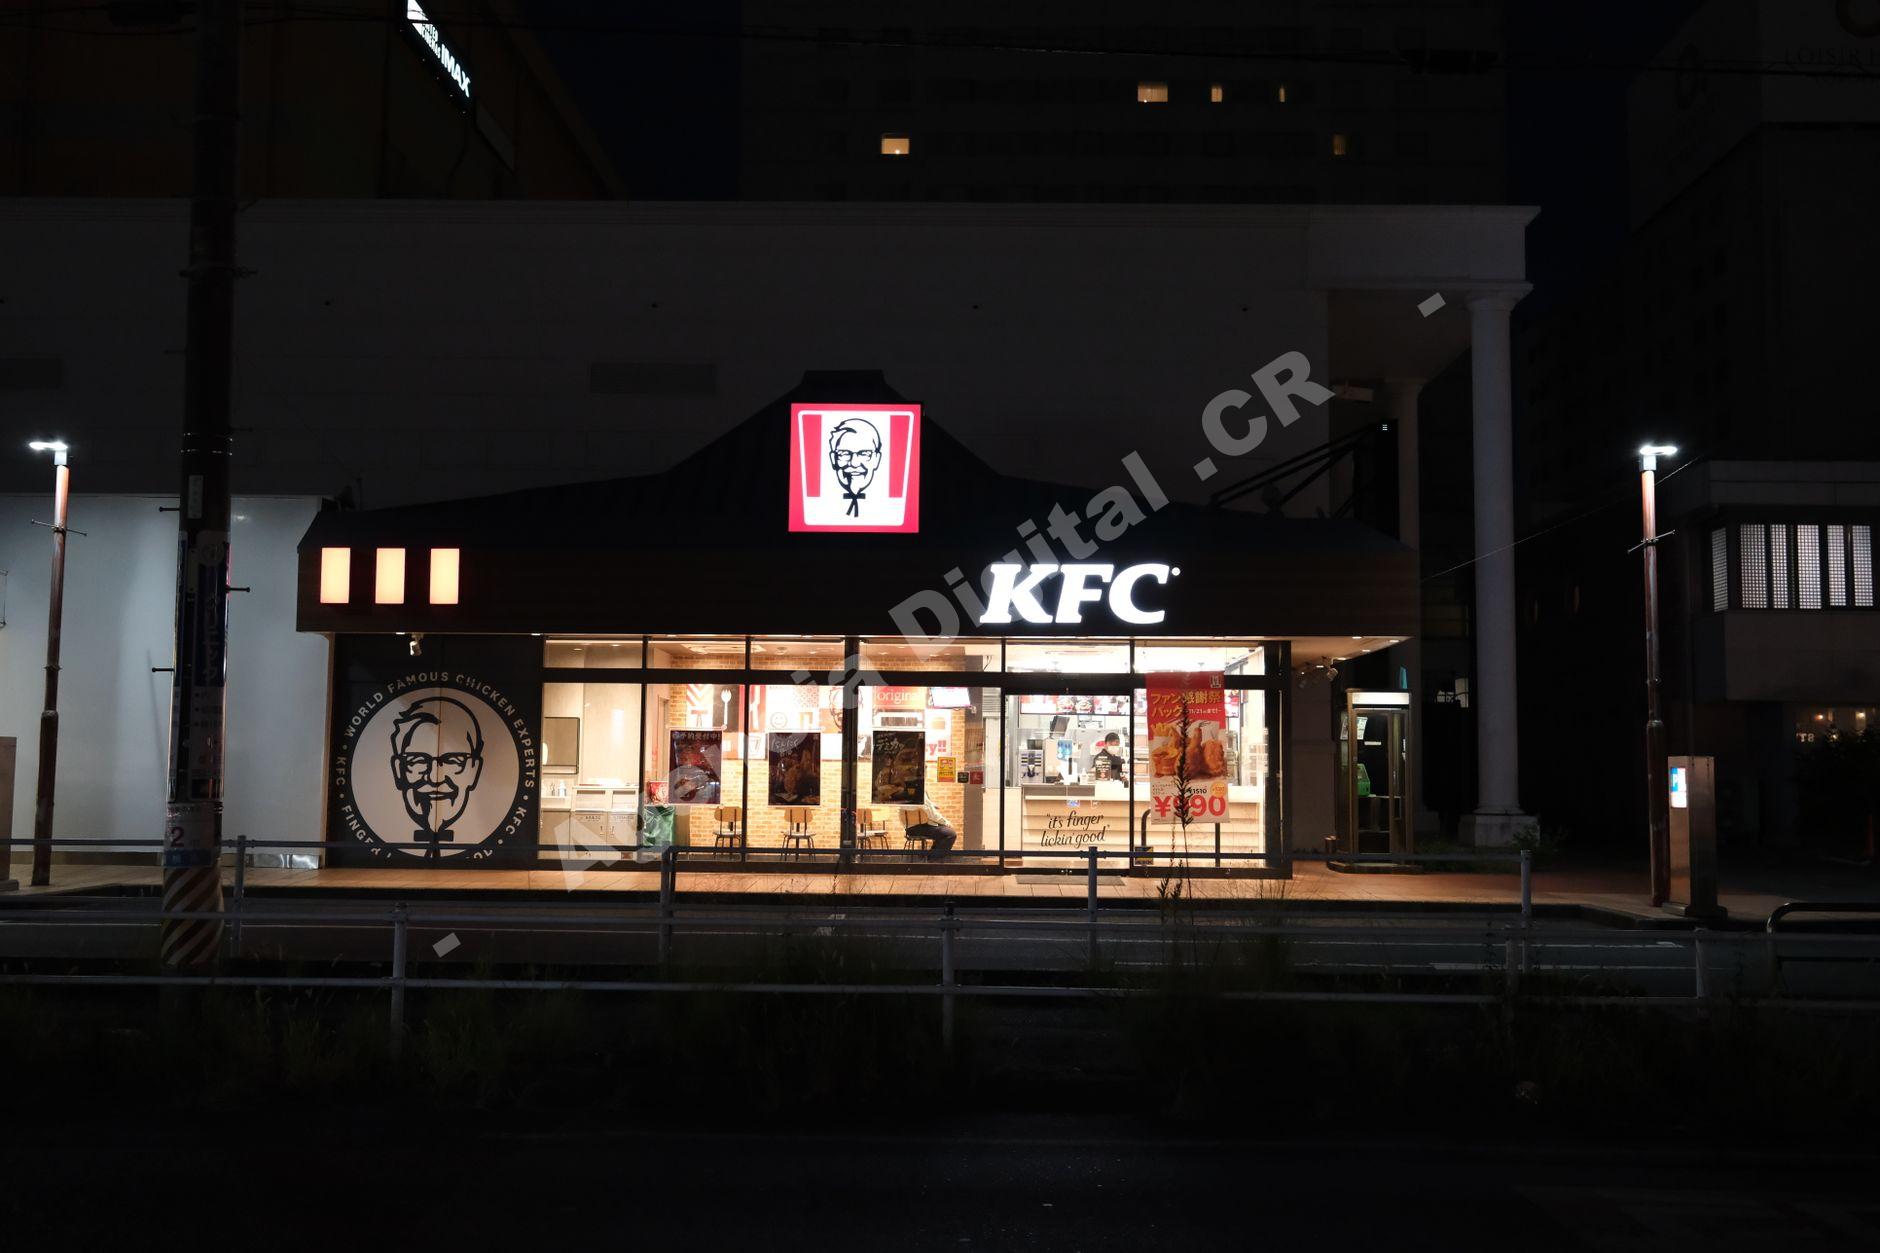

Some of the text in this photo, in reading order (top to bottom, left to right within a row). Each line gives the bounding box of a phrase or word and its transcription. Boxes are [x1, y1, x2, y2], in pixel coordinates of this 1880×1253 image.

[979, 562, 1170, 625] KFC
[344, 671, 535, 789] WORLD FAMOUS CHICKEN EXPERTS
[335, 754, 349, 786] KFC
[505, 805, 528, 836] KFC
[1067, 809, 1104, 832] finger
